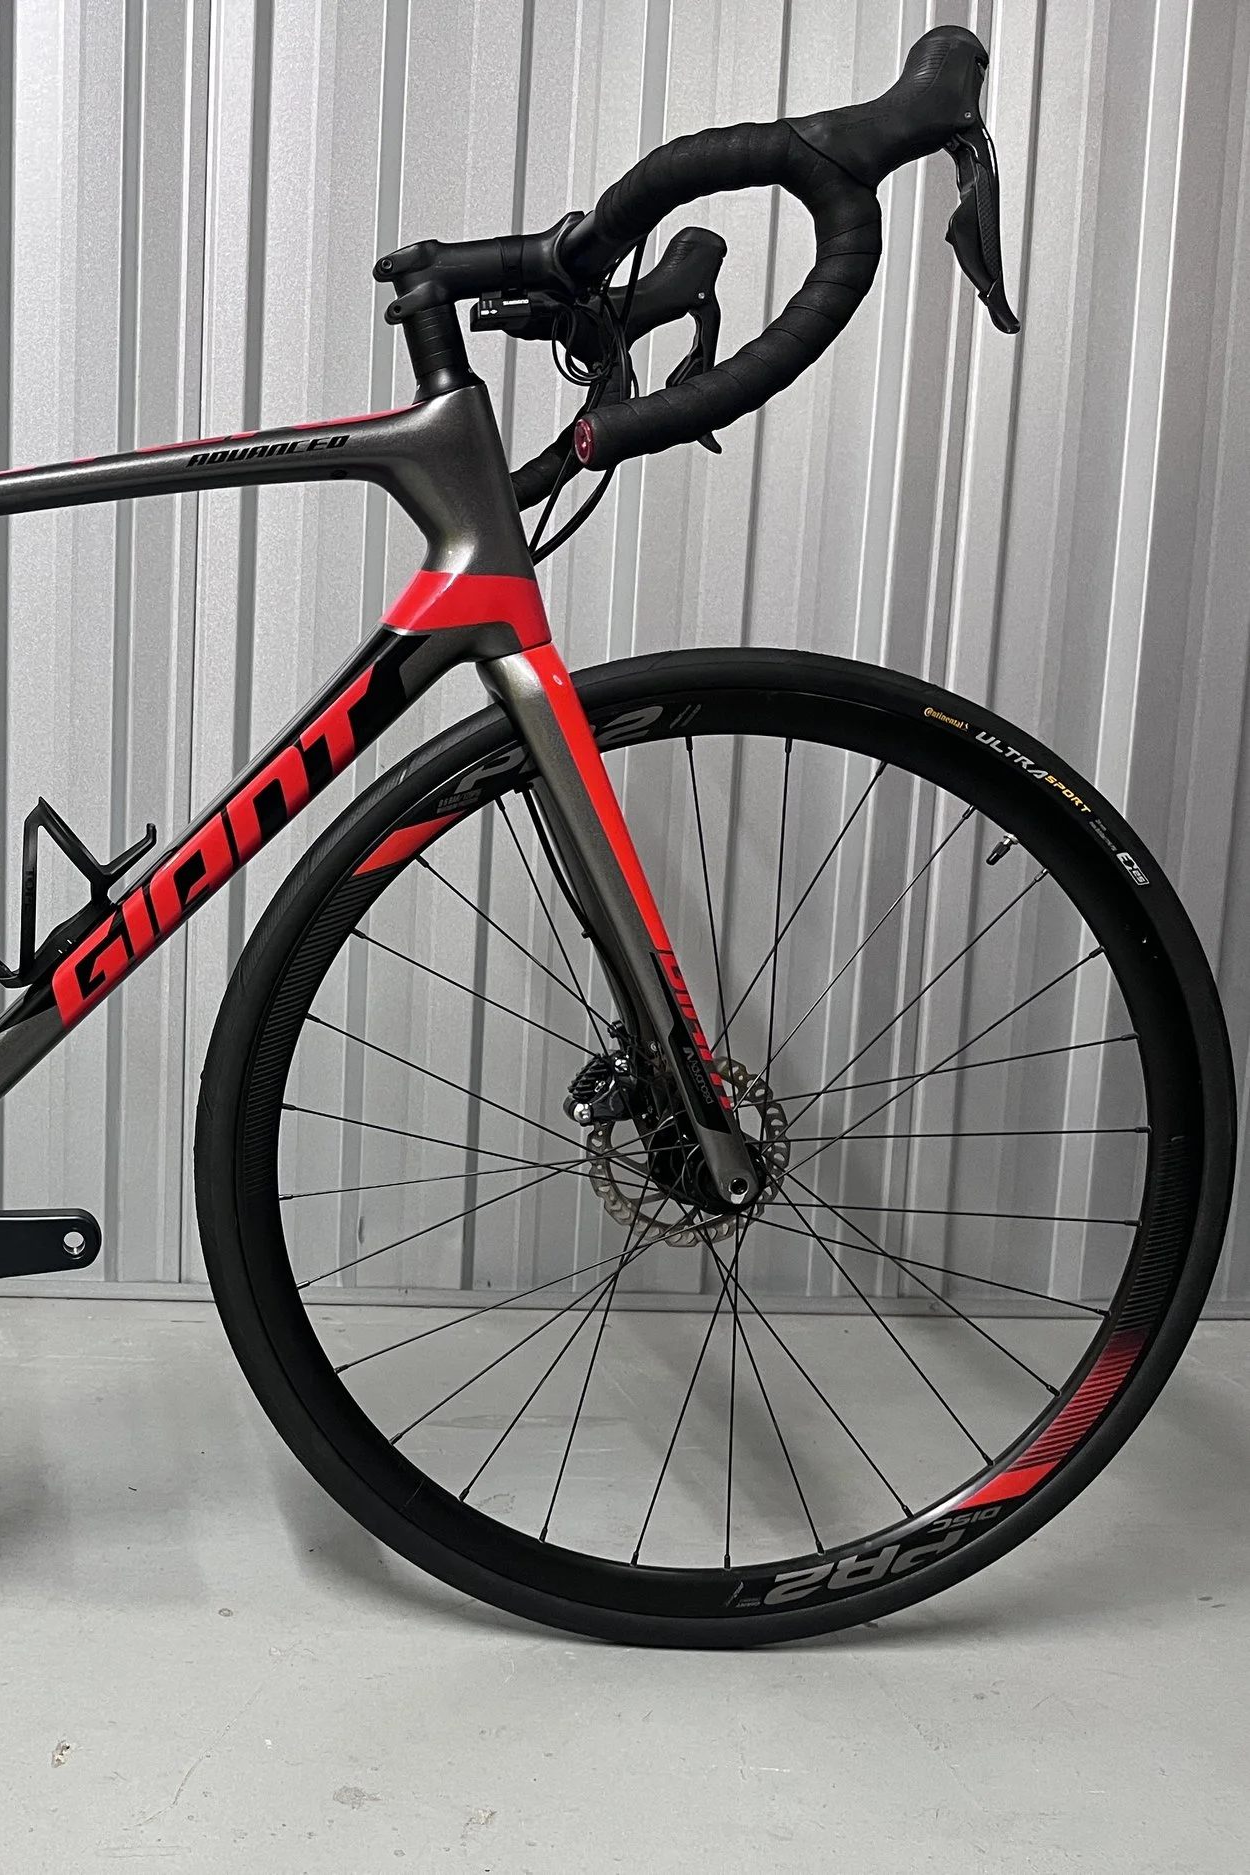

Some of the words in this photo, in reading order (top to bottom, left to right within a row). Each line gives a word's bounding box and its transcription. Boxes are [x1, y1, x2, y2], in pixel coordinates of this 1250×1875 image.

[186, 434, 350, 467] ADVANCED
[975, 731, 1049, 780] ULTRA
[1044, 775, 1092, 813] SPORT
[52, 664, 376, 1029] GIANT
[928, 1505, 1002, 1534] DISC
[764, 1528, 965, 1605] PR2
